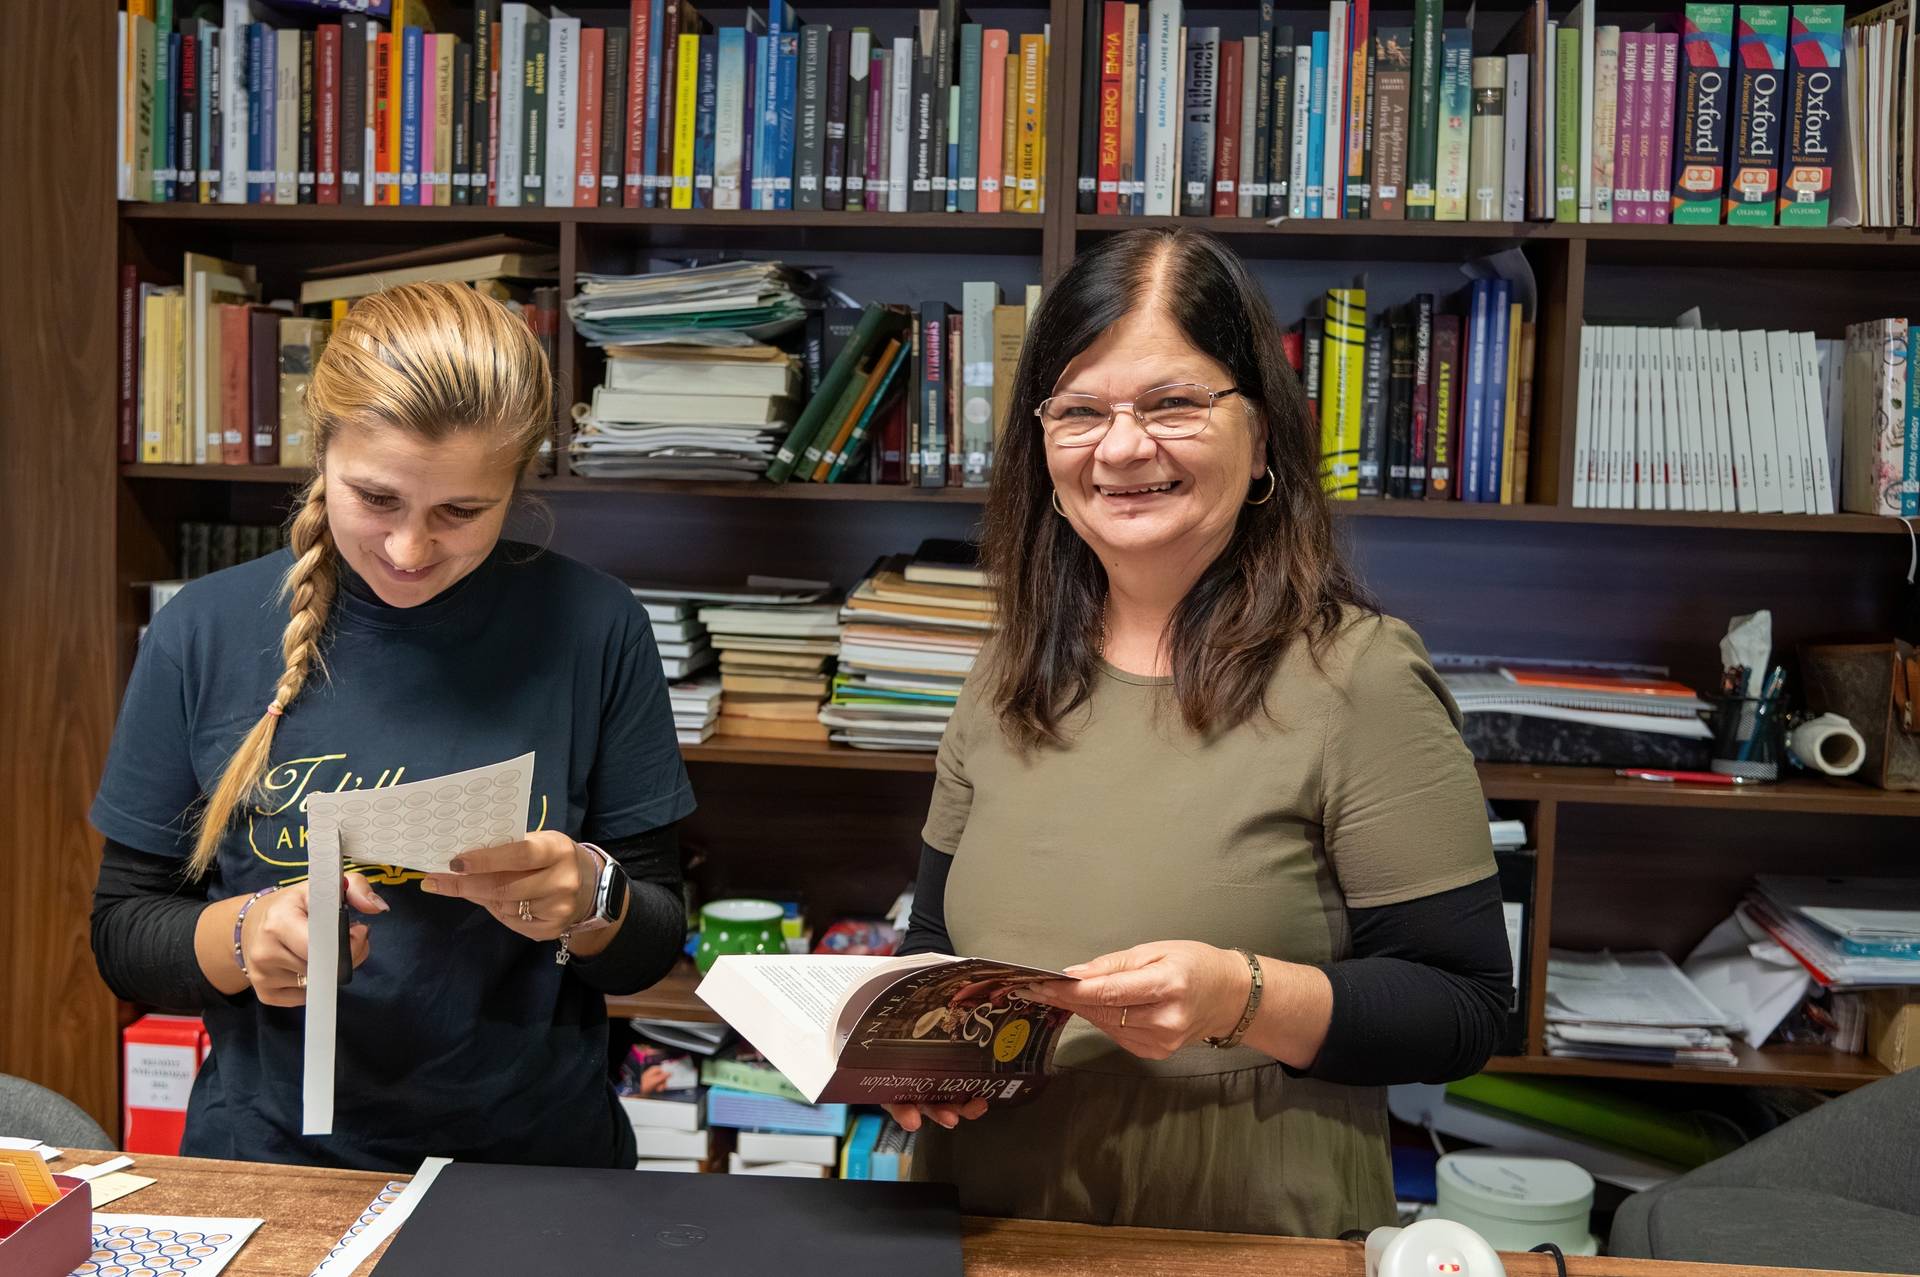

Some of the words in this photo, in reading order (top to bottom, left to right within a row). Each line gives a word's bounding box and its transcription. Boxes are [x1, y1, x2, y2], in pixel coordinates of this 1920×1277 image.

[560, 27, 568, 53] UTCA
[771, 23, 779, 34] 2.0
[1162, 12, 1170, 45] FRANK
[634, 15, 645, 94] KONFLIKTUSAI
[769, 36, 779, 74] TRAGÉDIÁJA
[805, 29, 817, 99] KÖNYVESBOLT
[1026, 42, 1037, 90] ÉLETFONÁL
[1105, 31, 1121, 75] EMMA
[1445, 48, 1457, 94] NOTRE-DAME
[1458, 48, 1471, 86] ASSZONYAI
[1623, 42, 1638, 81] NŐKNEK
[1641, 44, 1656, 82] NŐKNEK
[1661, 44, 1675, 82] NŐKNEK
[526, 60, 535, 87] NAGY
[534, 53, 545, 94] SÁNDOR
[558, 54, 568, 129] KELET-NYUGATI
[1187, 40, 1214, 108] kilencek
[1687, 72, 1698, 113] Advanced
[1795, 72, 1805, 113] Advanced
[633, 95, 644, 126] ANYA
[1026, 92, 1035, 104] AZ
[1104, 88, 1118, 128] RENO
[1392, 104, 1403, 112] A
[1696, 72, 1722, 154] Oxford
[1742, 74, 1752, 115] Advanced
[1804, 72, 1831, 154] Oxford
[805, 104, 815, 139] SARKI
[919, 92, 930, 140] képrablás
[1190, 113, 1211, 124] A
[1684, 113, 1694, 153] Learner's
[1751, 74, 1777, 156] Oxford
[1792, 115, 1803, 154] Learner's
[633, 129, 643, 151] EGY
[1103, 132, 1116, 167] JEAN
[1739, 116, 1749, 155] Learner's
[919, 143, 928, 179] éptelen
[1417, 303, 1431, 347] KÖNYVE
[925, 321, 940, 382] NYIKORGÁS
[1416, 347, 1428, 386] TITKOK
[1909, 415, 1920, 451] GYÖRGY
[861, 995, 905, 1050] ANNE
[859, 1074, 938, 1095] Divatszalon
[894, 1093, 930, 1101] JACOBS
[938, 1078, 1007, 1100] Rosen
